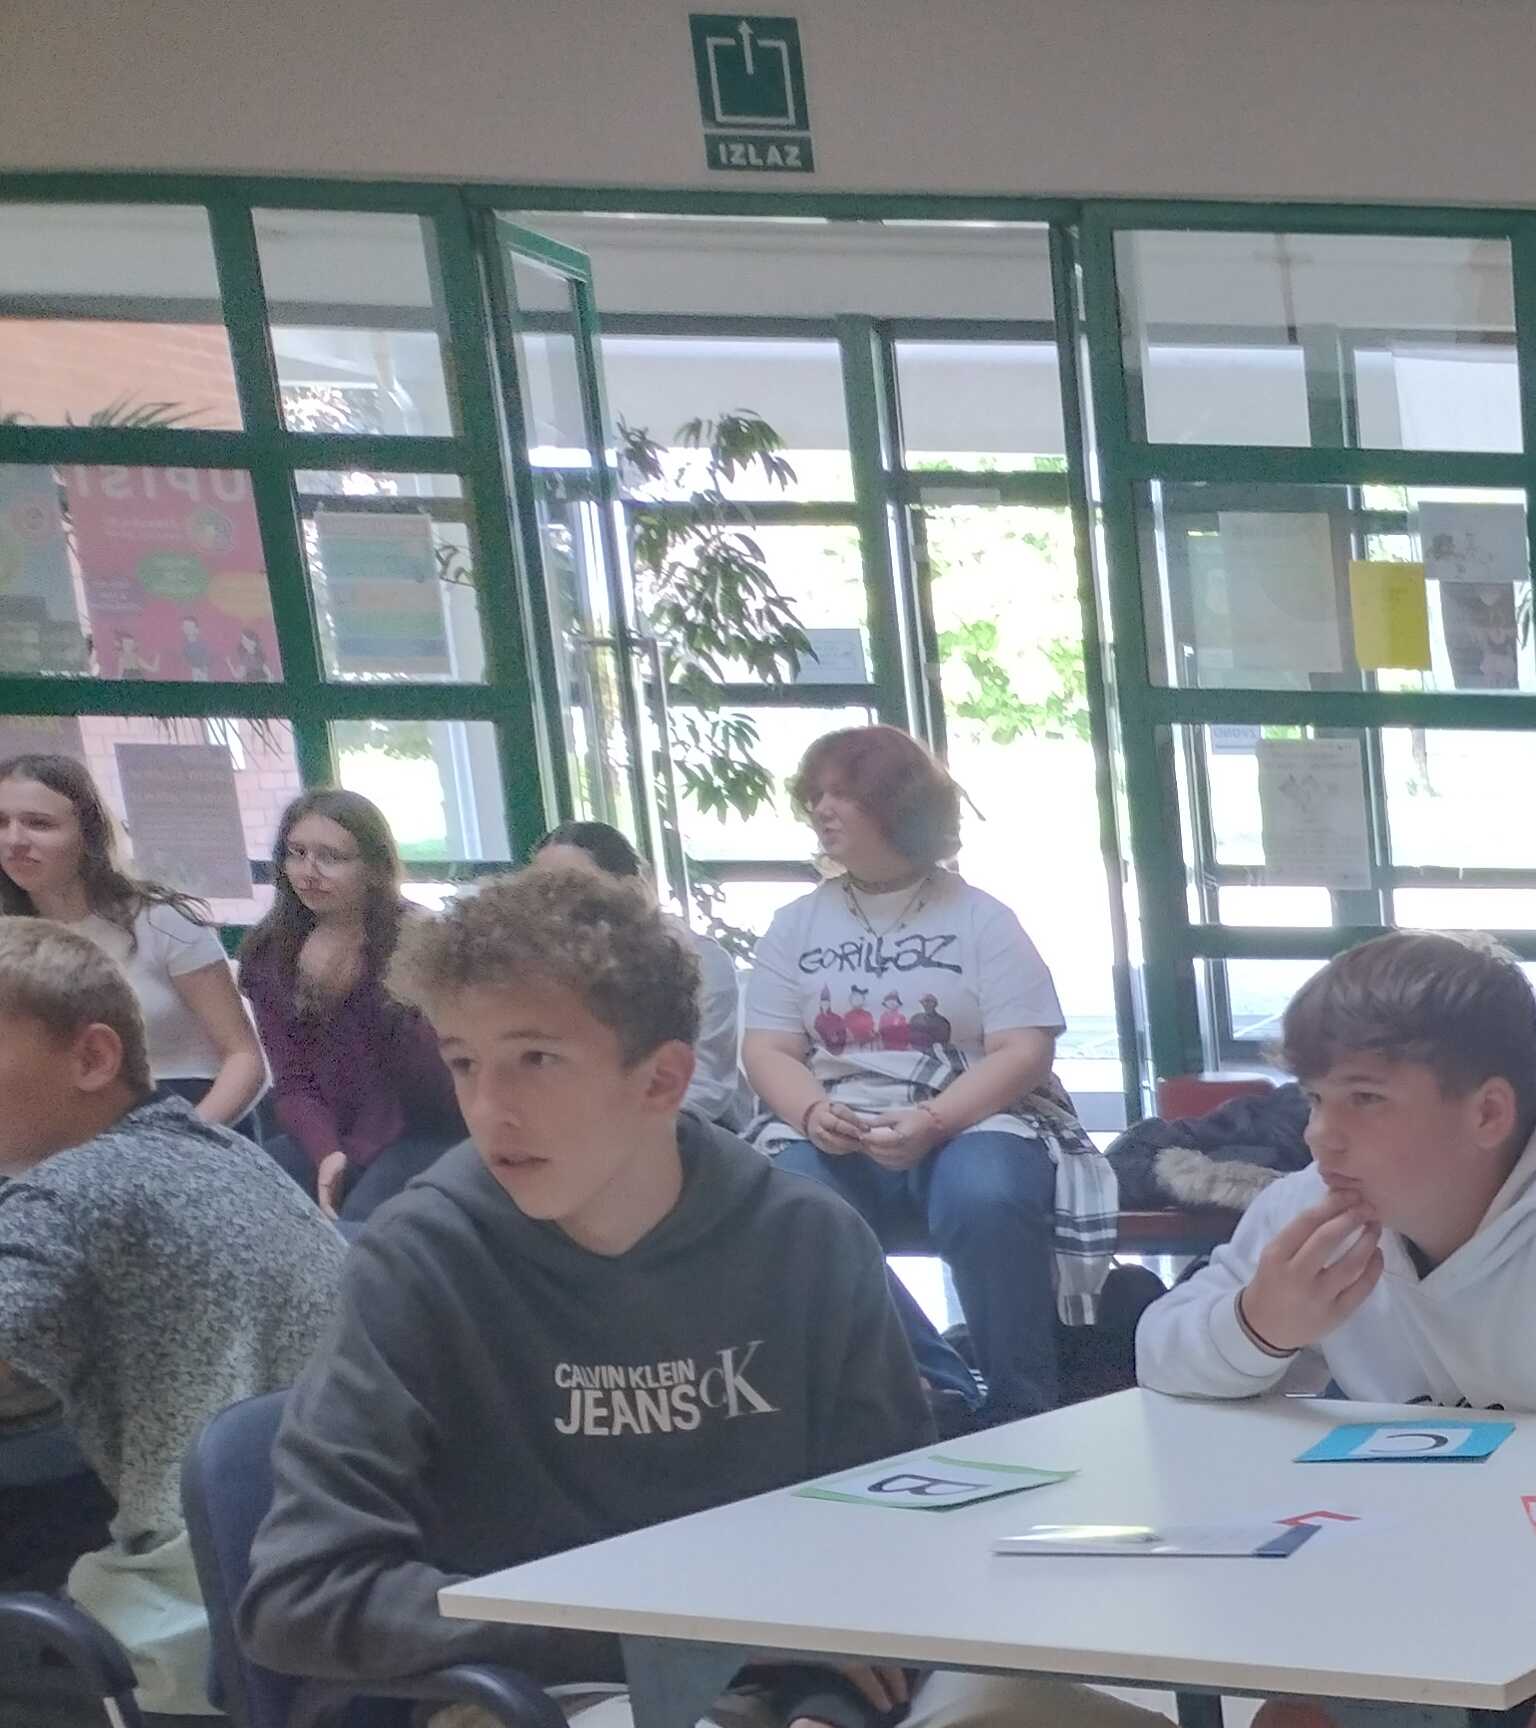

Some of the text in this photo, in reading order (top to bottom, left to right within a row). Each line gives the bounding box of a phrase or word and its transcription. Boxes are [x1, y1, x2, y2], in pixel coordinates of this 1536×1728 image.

[719, 142, 802, 167] IZLAZ
[554, 1358, 696, 1389] CALVIN KLEIN
[554, 1384, 701, 1436] JEANS
[867, 1474, 993, 1496] B
